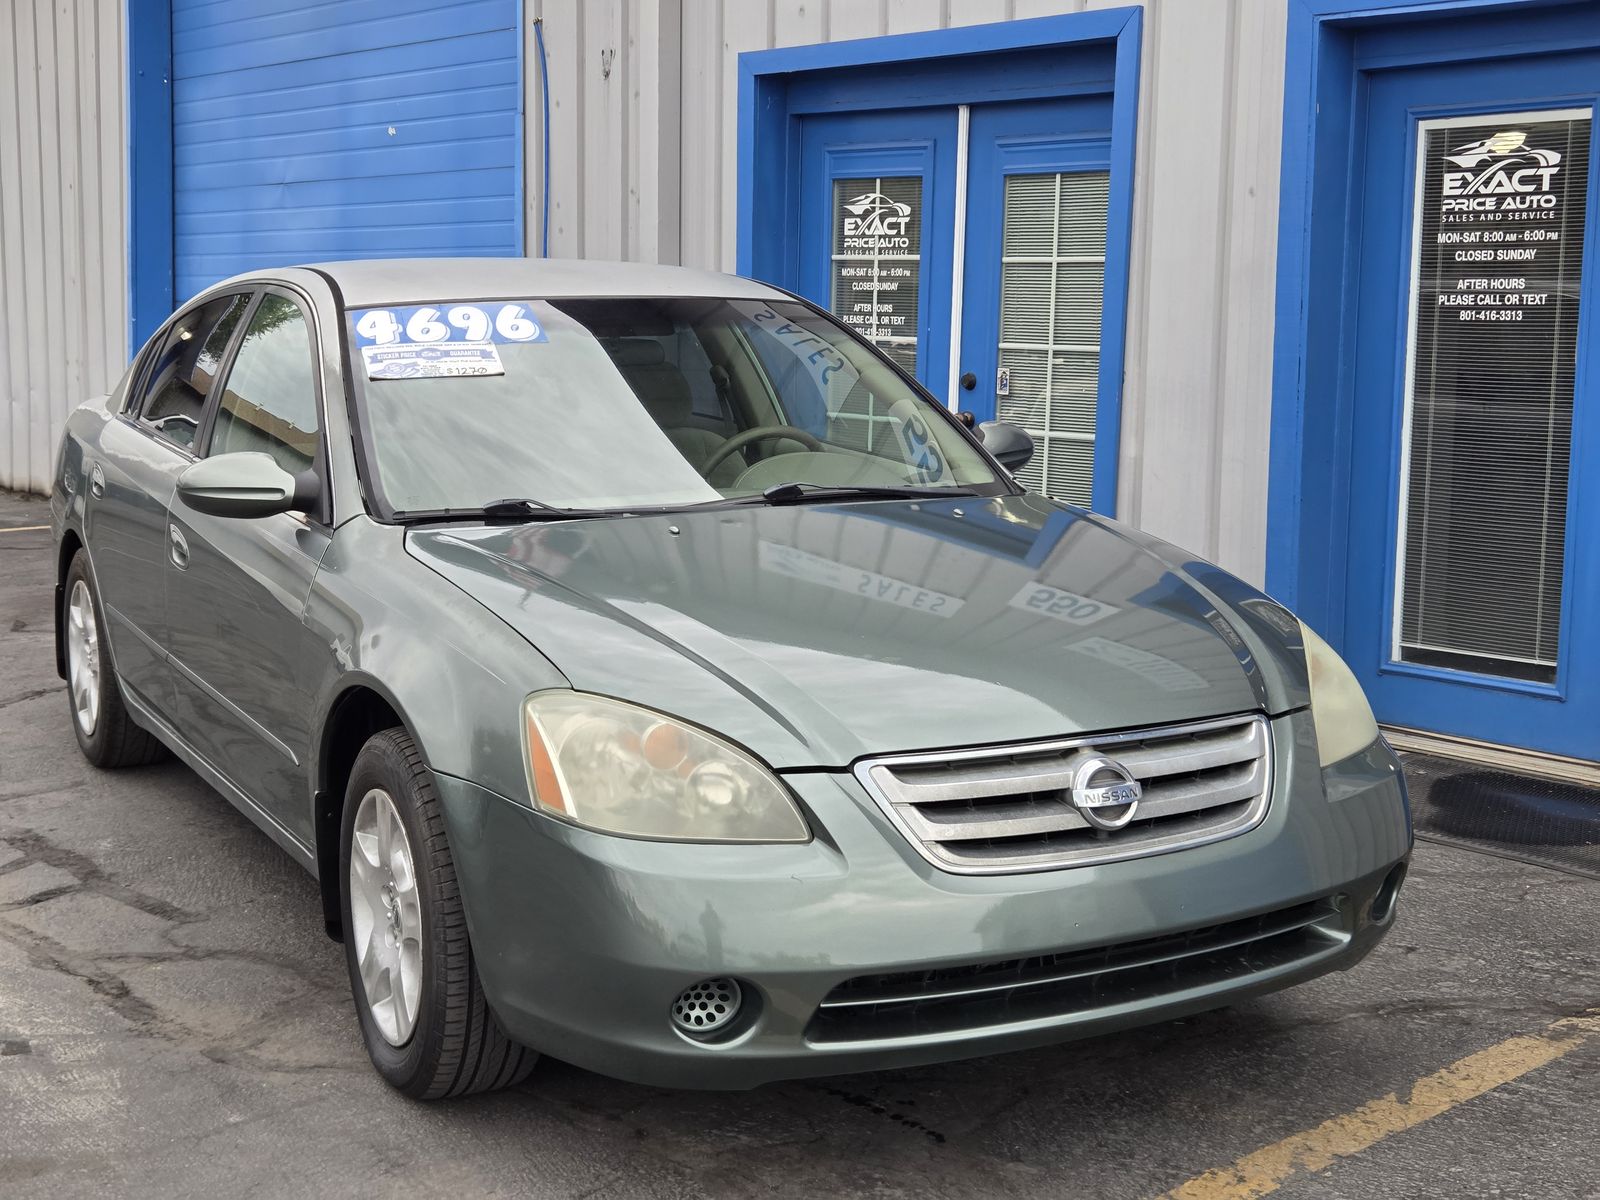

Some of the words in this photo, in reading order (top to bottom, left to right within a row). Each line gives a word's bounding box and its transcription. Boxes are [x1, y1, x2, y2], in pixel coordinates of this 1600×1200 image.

[1442, 166, 1561, 196] EXACT
[1442, 197, 1497, 212] PRICE
[1500, 194, 1557, 210] AUTO
[1441, 213, 1474, 223] SALES
[1480, 212, 1502, 221] AND
[1508, 210, 1556, 220] SERVICE
[843, 215, 911, 236] EXACT
[1437, 231, 1482, 243] MON-SAT
[1483, 231, 1504, 242] 8:00
[1504, 233, 1517, 241] AM
[1524, 229, 1545, 240] 6:00
[1546, 232, 1559, 240] PM
[843, 237, 875, 248] PRICE
[877, 237, 909, 248] AUTO
[1455, 249, 1495, 261] CLOSED
[1497, 248, 1537, 260] SUNDAY
[841, 267, 867, 277] MON-SAT
[851, 281, 875, 291] CLOSED
[875, 282, 899, 291] SUNDAY
[1457, 279, 1488, 290] AFTER
[1490, 278, 1526, 289] HOURS
[1438, 294, 1475, 305] PLEASE
[1477, 294, 1502, 305] CALL
[1504, 293, 1520, 305] OR
[1522, 293, 1548, 304] TEXT
[853, 303, 872, 312] AFTER
[842, 315, 864, 324] PLEASE
[880, 316, 890, 325] OR
[890, 316, 906, 325] TEXT
[1459, 310, 1523, 321] 801-416-3313
[355, 304, 541, 345] 4696
[1084, 787, 1138, 805] NISSAN
